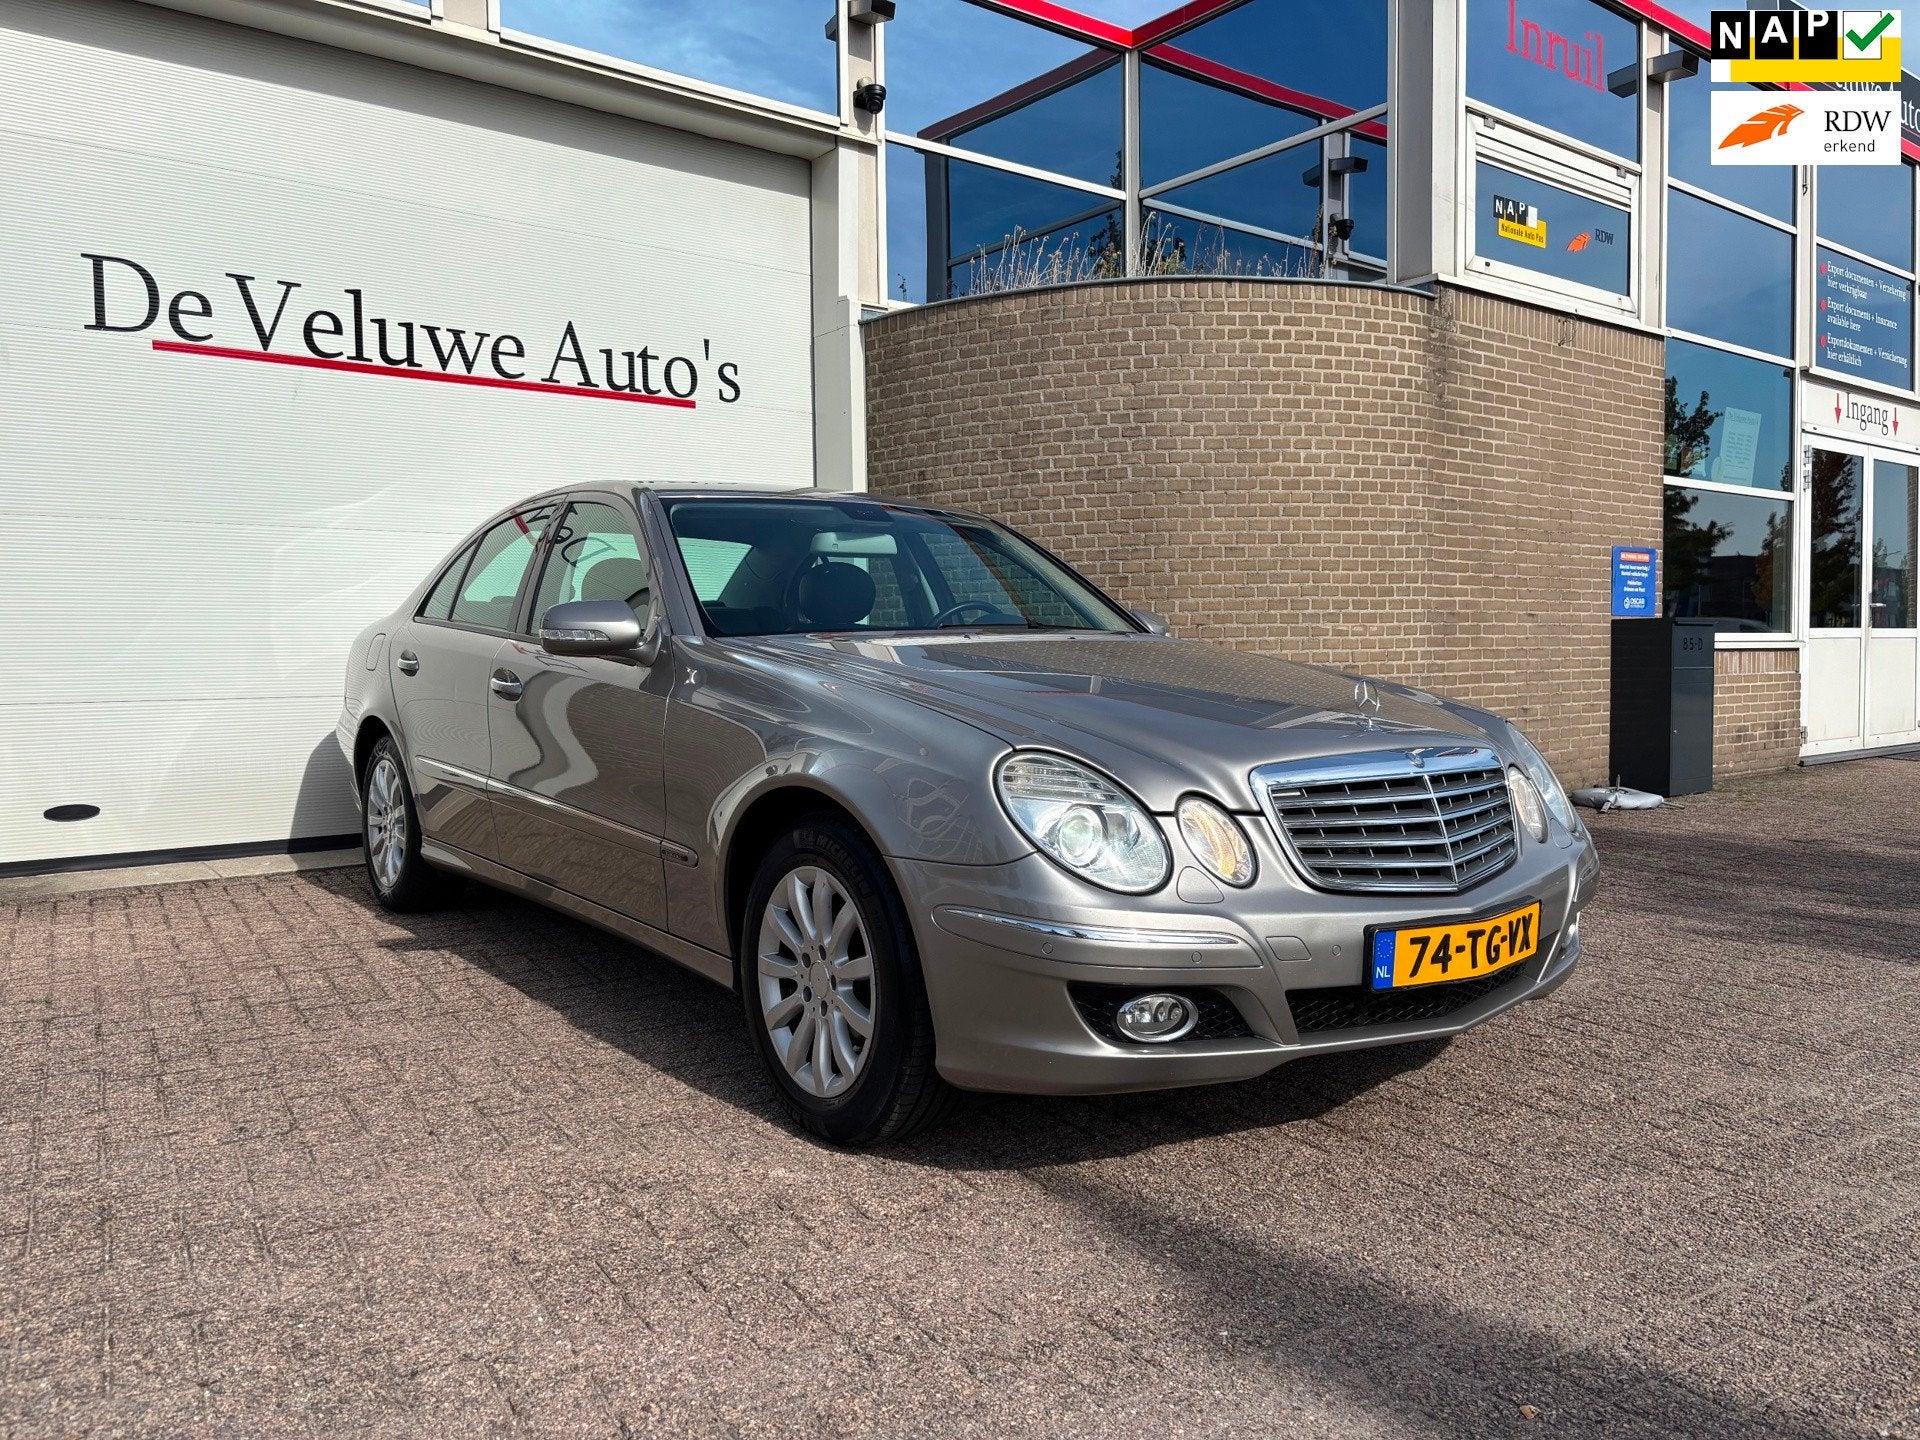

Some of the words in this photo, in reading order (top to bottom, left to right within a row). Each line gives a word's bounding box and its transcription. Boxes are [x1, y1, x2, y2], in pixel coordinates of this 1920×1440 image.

[1504, 0, 1605, 93] Inruil
[1495, 199, 1526, 215] NAP
[1501, 222, 1524, 237] Nationale
[1524, 229, 1536, 241] Auto
[1594, 228, 1614, 245] RDW
[1827, 260, 1844, 277] Export
[1845, 267, 1874, 287] documenten
[1879, 279, 1907, 302] Verzekering
[1827, 275, 1838, 289] hier
[1838, 282, 1868, 299] verkrijgbaar
[1827, 296, 1844, 313] Export
[1845, 303, 1871, 320] documents
[1875, 312, 1898, 329] Insurance
[1827, 314, 1849, 329] available
[1849, 318, 1861, 331] here
[81, 253, 213, 342] De
[225, 272, 526, 379] Veluwe
[541, 320, 742, 403] Auto's
[1827, 347, 1838, 360] hier
[1877, 347, 1908, 369] Versicherung
[1846, 392, 1888, 435] Ingang
[1409, 913, 1533, 978] 74-TG-VX
[1376, 966, 1390, 978] NL
